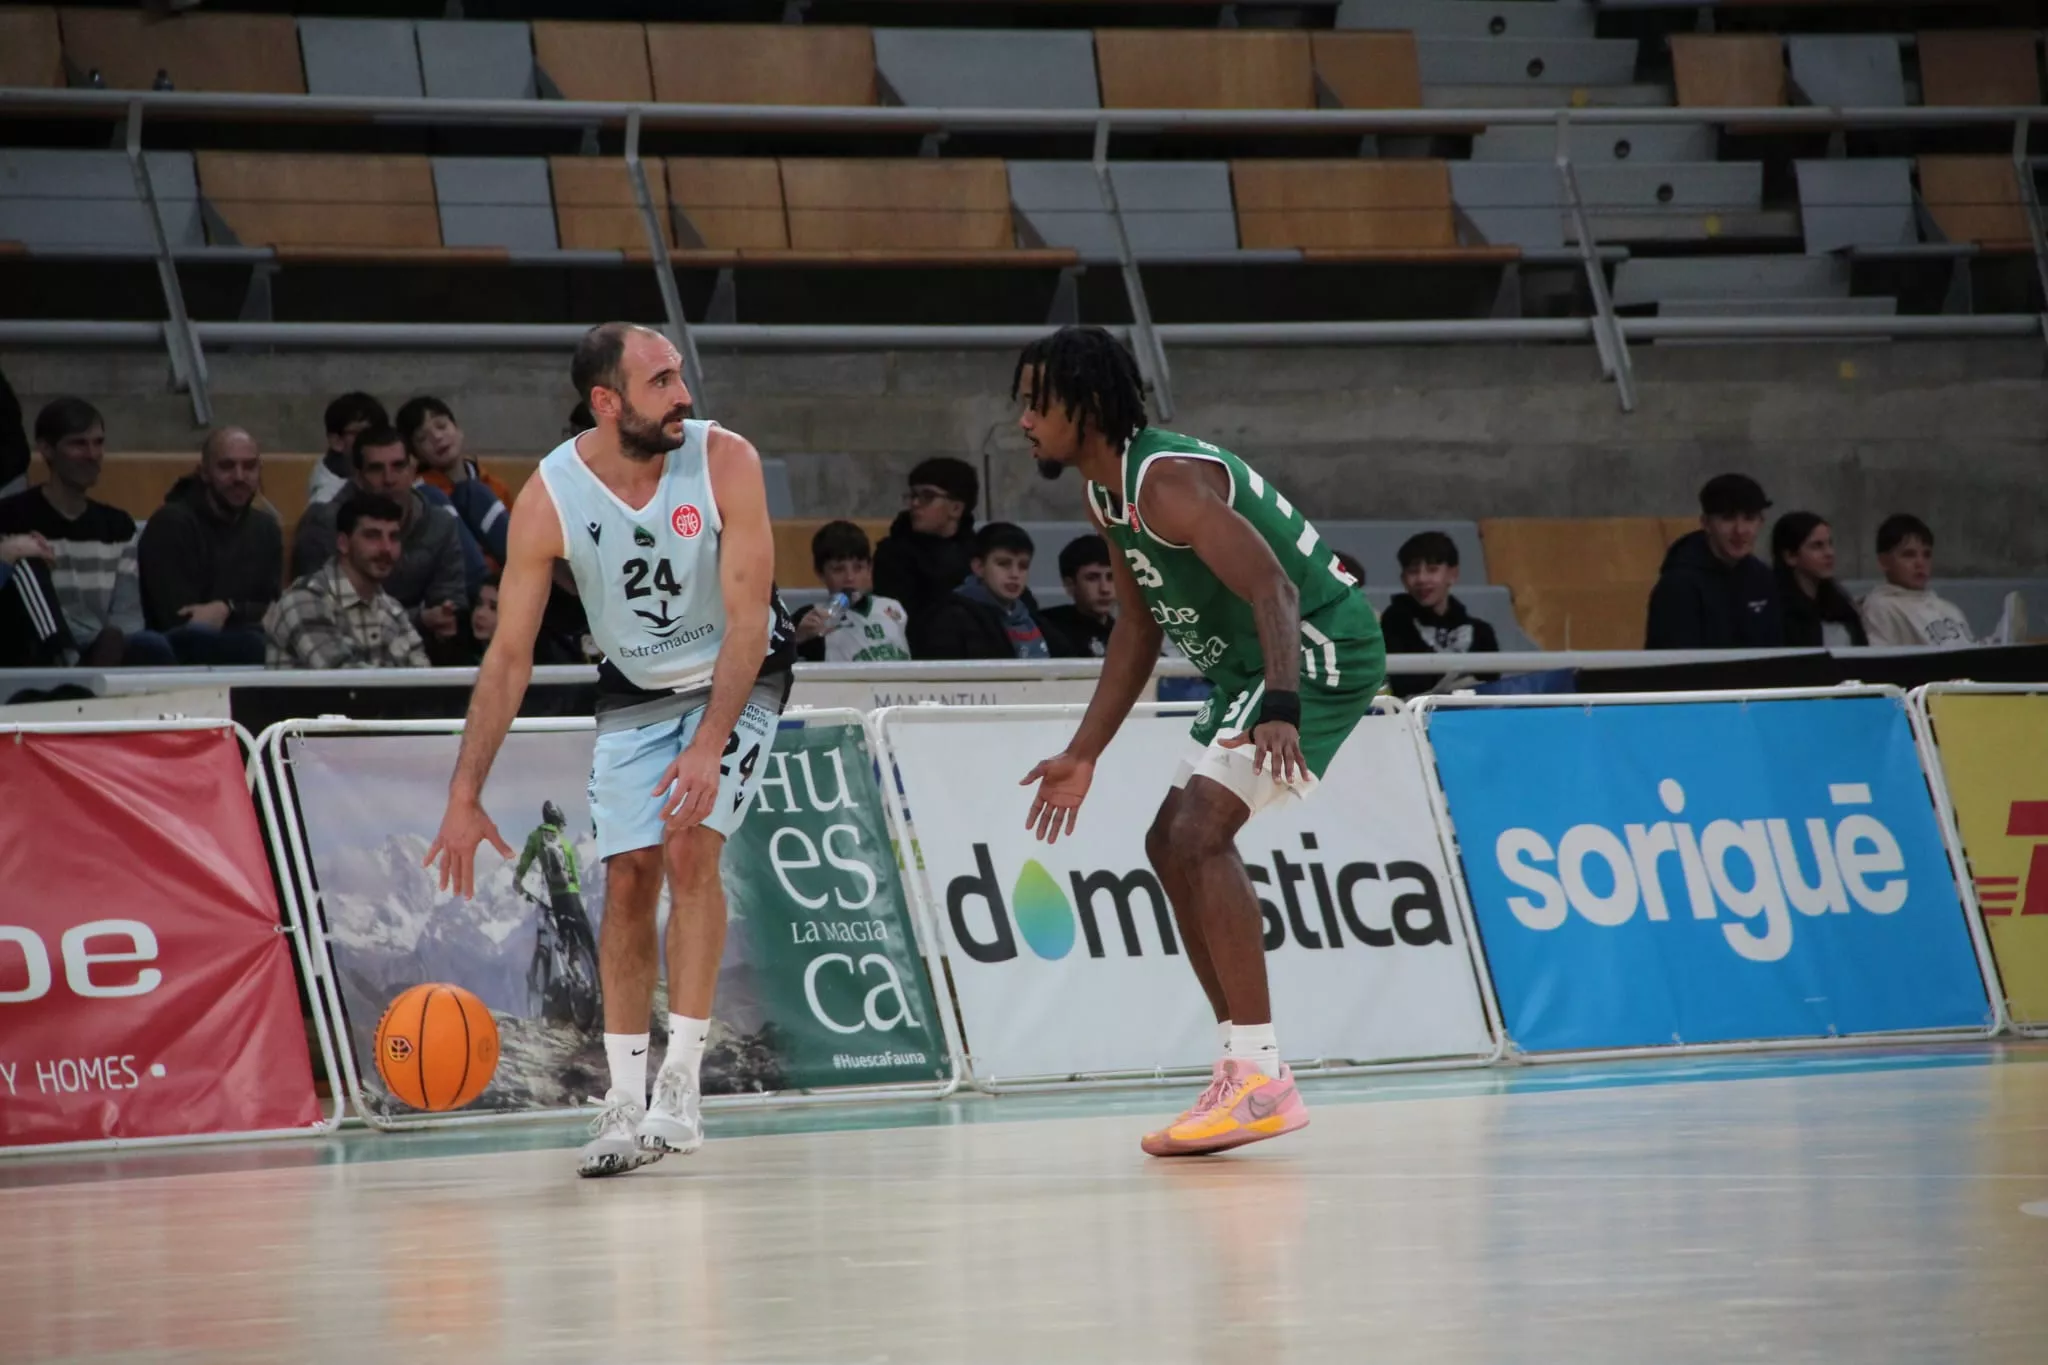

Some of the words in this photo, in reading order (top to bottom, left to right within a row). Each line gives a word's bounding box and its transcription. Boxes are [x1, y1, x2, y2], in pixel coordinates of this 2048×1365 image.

[623, 557, 682, 600] 24
[620, 621, 715, 659] Extremadura
[946, 832, 1453, 964] domstica
[36, 1055, 139, 1095] HOMES
